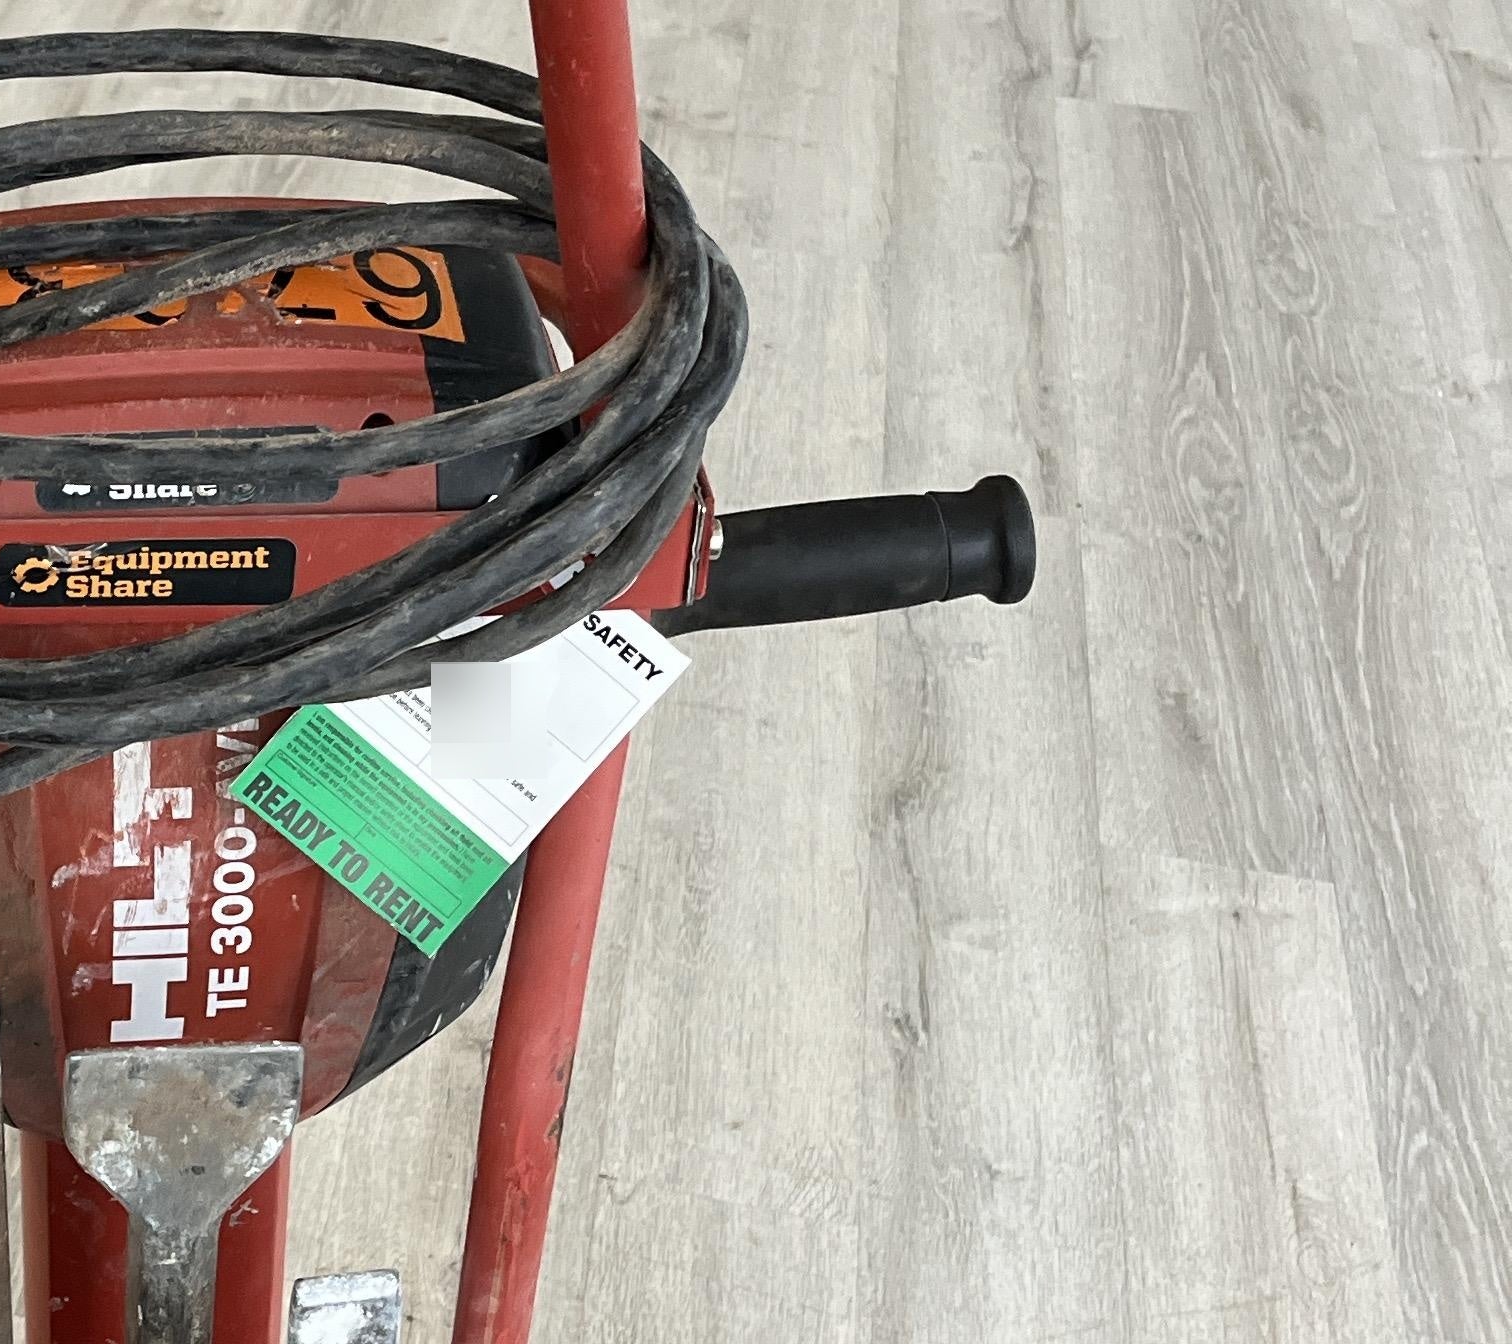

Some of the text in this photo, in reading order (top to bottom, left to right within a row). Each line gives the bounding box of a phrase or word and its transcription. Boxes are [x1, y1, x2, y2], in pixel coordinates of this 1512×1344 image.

[65, 575, 174, 599] Share
[67, 545, 269, 576] Equipment
[582, 612, 664, 683] SAFETY
[242, 771, 445, 944] READY TO RENT
[110, 741, 193, 1043] HILT
[205, 966, 250, 1018] TE
